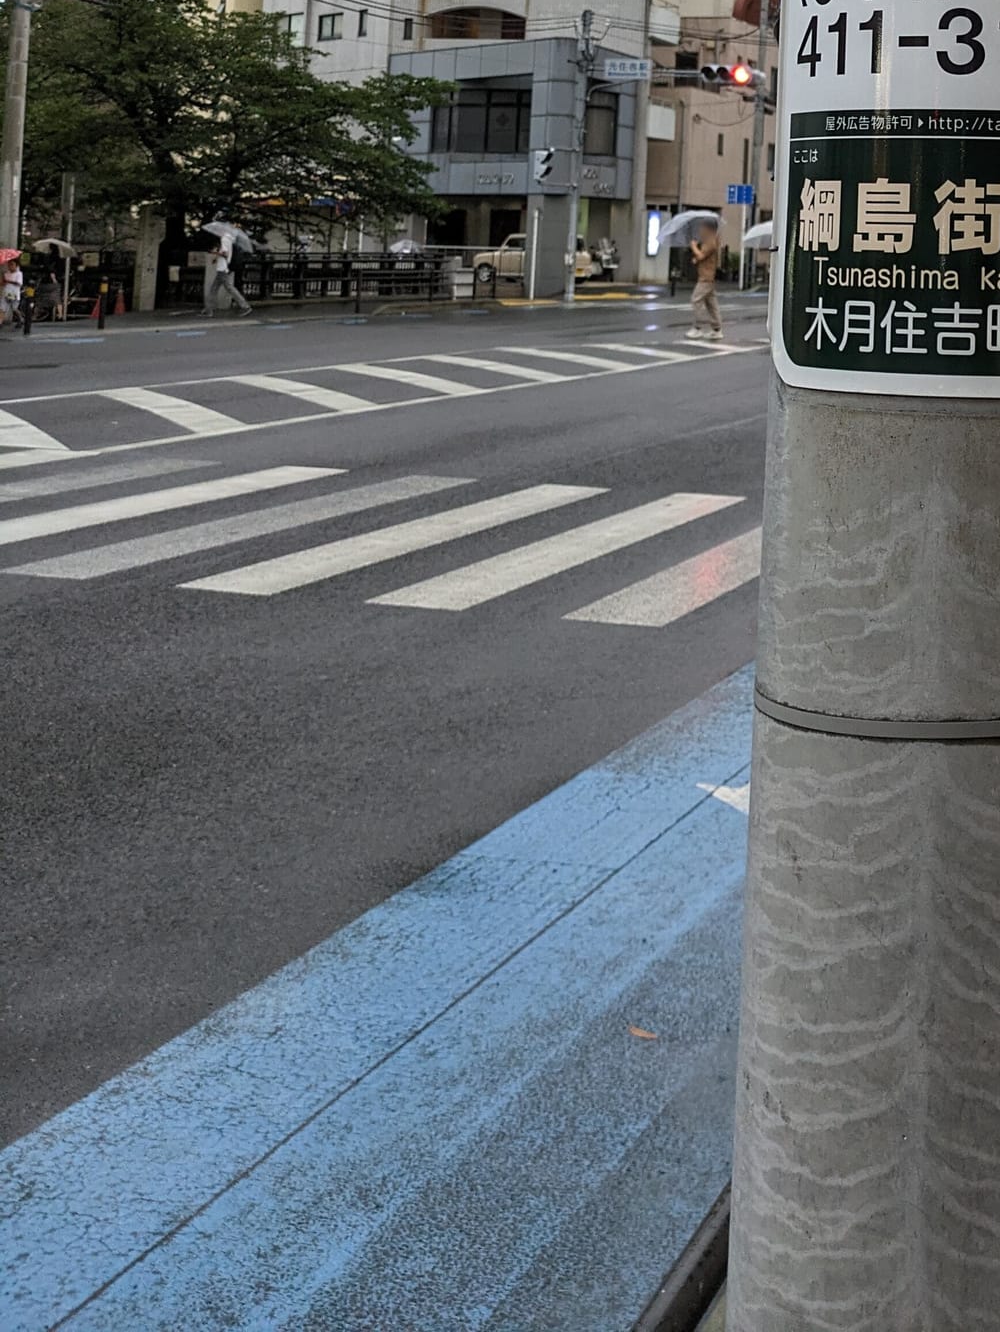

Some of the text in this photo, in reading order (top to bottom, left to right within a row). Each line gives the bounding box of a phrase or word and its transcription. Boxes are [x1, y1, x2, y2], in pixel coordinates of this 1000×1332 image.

[825, 115, 913, 131] 屋外広告物許可
[793, 149, 818, 164] ここは
[813, 256, 960, 290] Tsunashima
